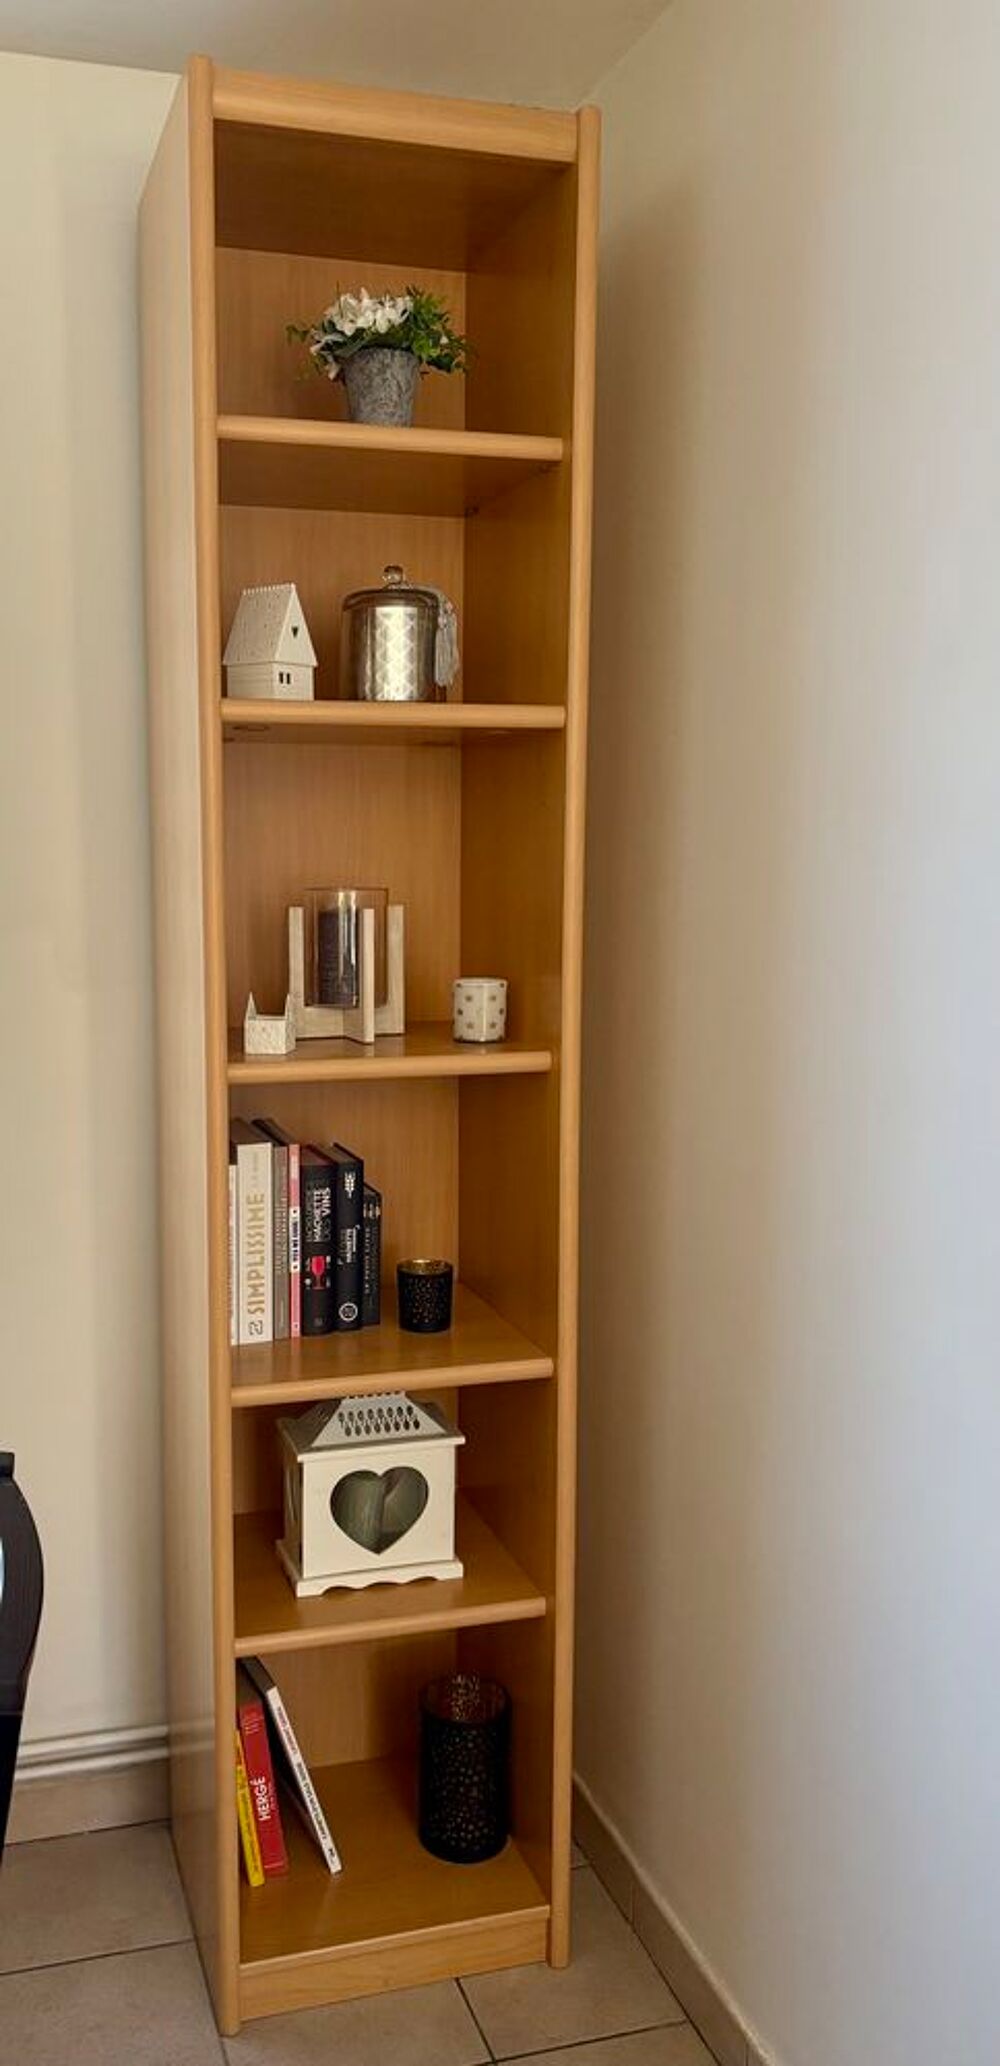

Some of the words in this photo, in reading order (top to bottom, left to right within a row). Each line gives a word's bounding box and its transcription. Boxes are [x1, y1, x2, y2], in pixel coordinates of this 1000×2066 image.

[313, 1191, 322, 1242] HACHETTE
[322, 1187, 331, 1216] VINS
[247, 1193, 265, 1314] SIMPLISSIME
[250, 1776, 271, 1822] HERGÉ
